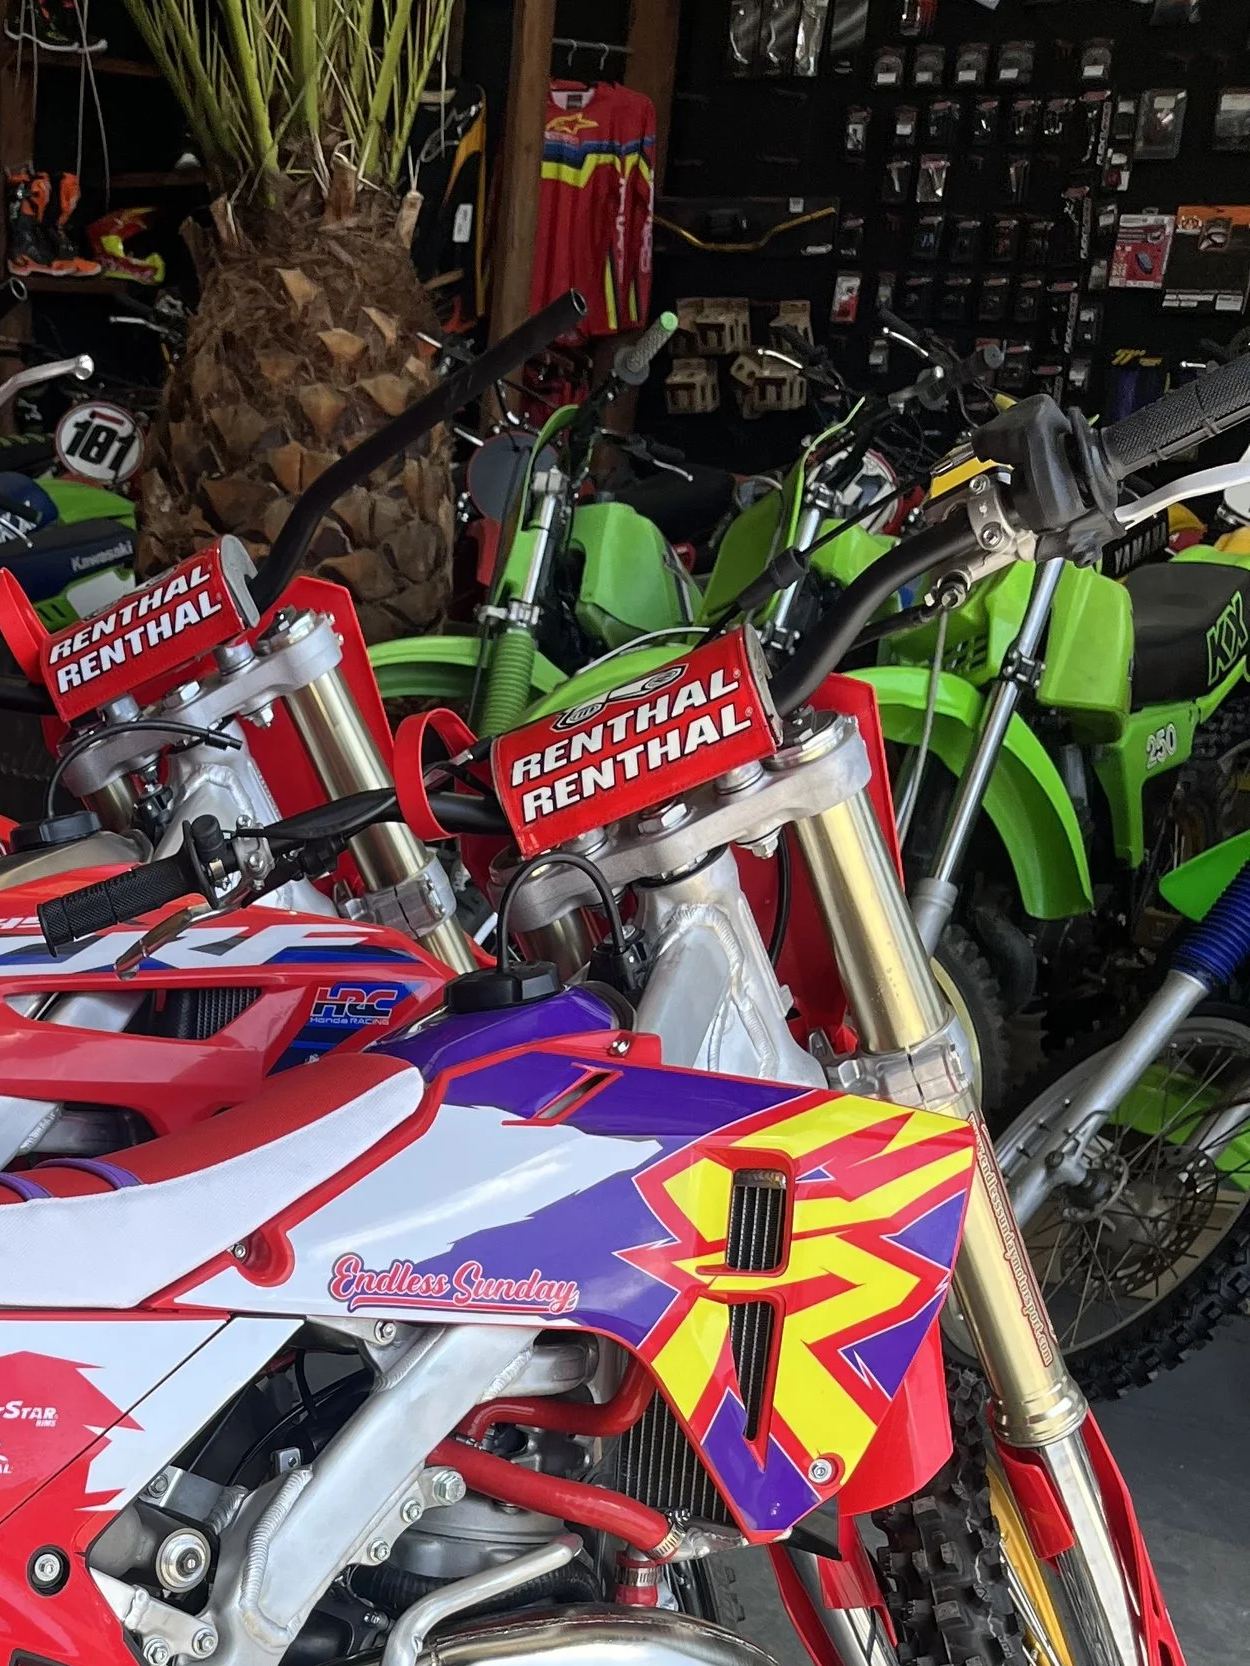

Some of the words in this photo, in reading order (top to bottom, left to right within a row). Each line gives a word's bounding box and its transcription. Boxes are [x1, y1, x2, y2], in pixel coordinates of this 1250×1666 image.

[63, 419, 137, 477] 181
[70, 540, 134, 572] Kawasaki
[49, 563, 213, 665] RENTHAL
[57, 589, 223, 695] RENTHAL
[1206, 590, 1248, 687] KX
[510, 668, 740, 788] RENTHAL
[1146, 723, 1177, 770] 250
[522, 703, 752, 824] RENTHAL
[310, 986, 399, 1019] HRC
[310, 1016, 349, 1025] Honda
[350, 1018, 390, 1026] RACING
[330, 1253, 450, 1302] Endless
[452, 1259, 580, 1315] Sunday
[36, 1419, 57, 1428] RIMS
